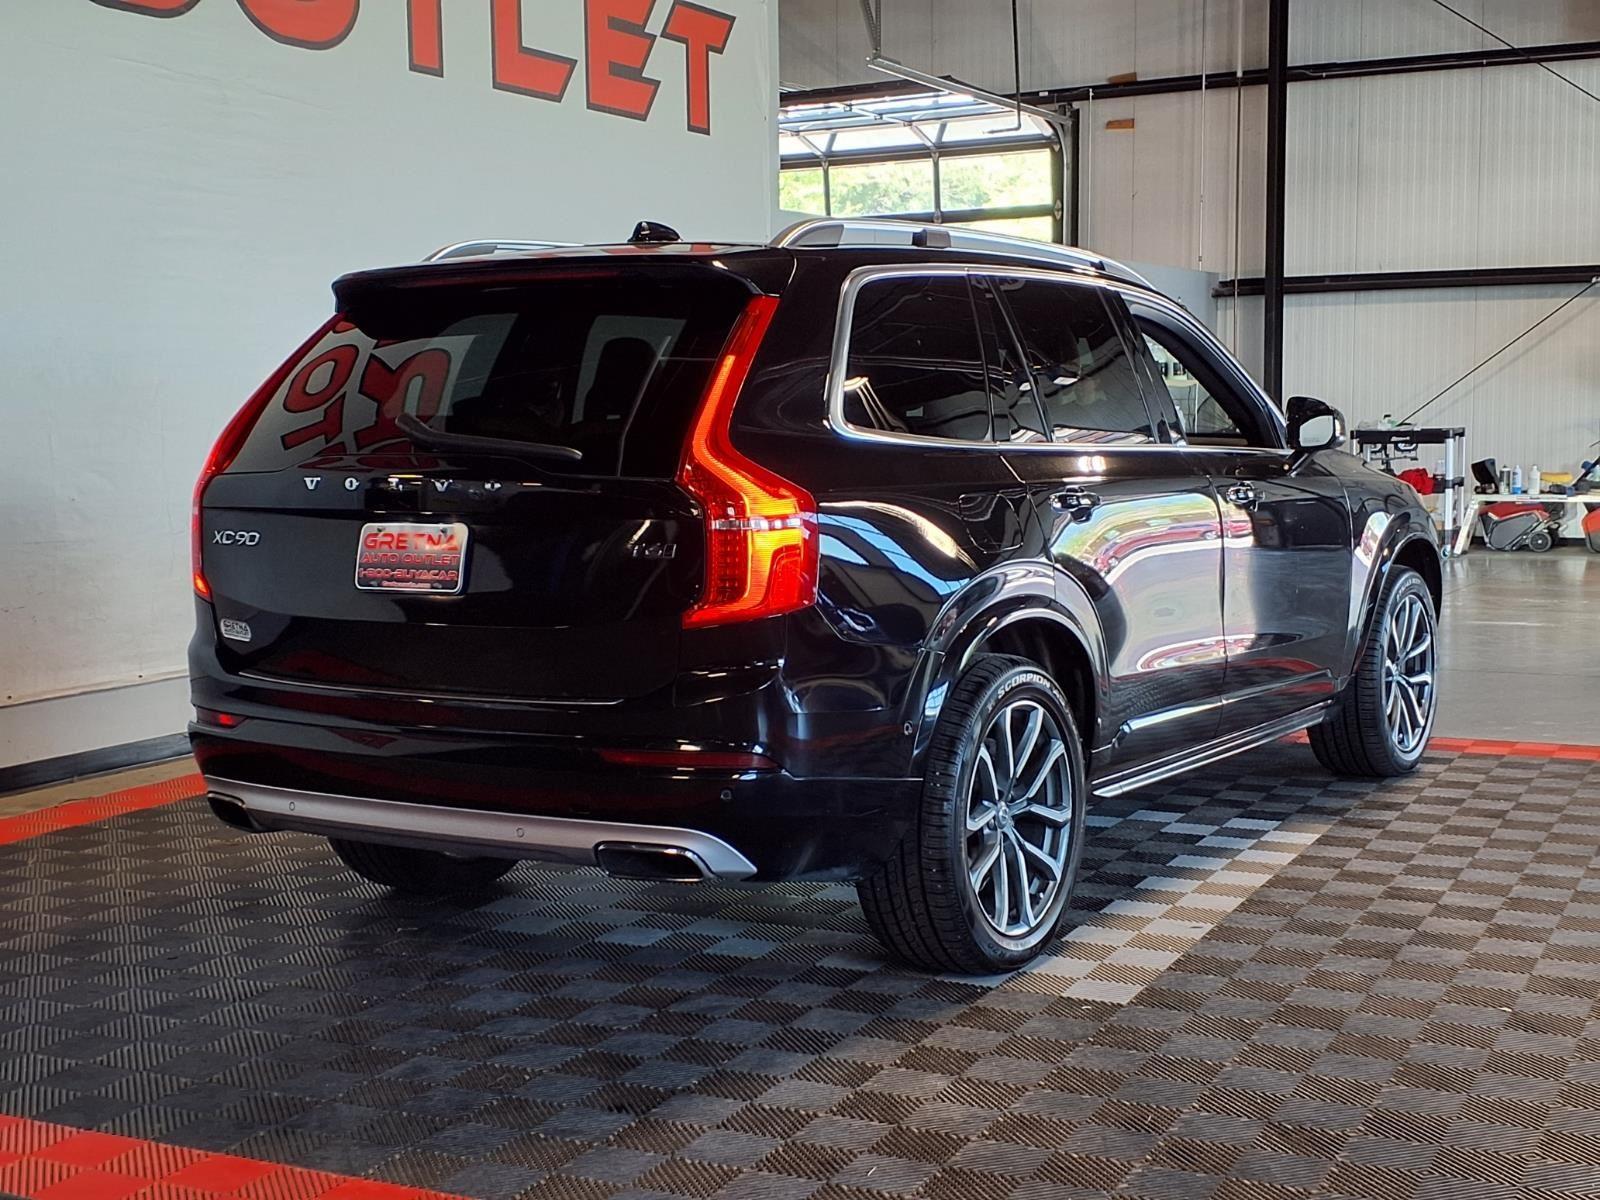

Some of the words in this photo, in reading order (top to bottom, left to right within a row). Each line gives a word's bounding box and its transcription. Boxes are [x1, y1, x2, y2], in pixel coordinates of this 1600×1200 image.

[88, 0, 735, 135] LET
[304, 476, 502, 492] VOLVO
[212, 530, 260, 545] XC90
[364, 532, 459, 550] GRETNA
[361, 552, 399, 565] AUTO
[402, 554, 460, 566] OUTLET
[997, 672, 1051, 699] SCORPION
